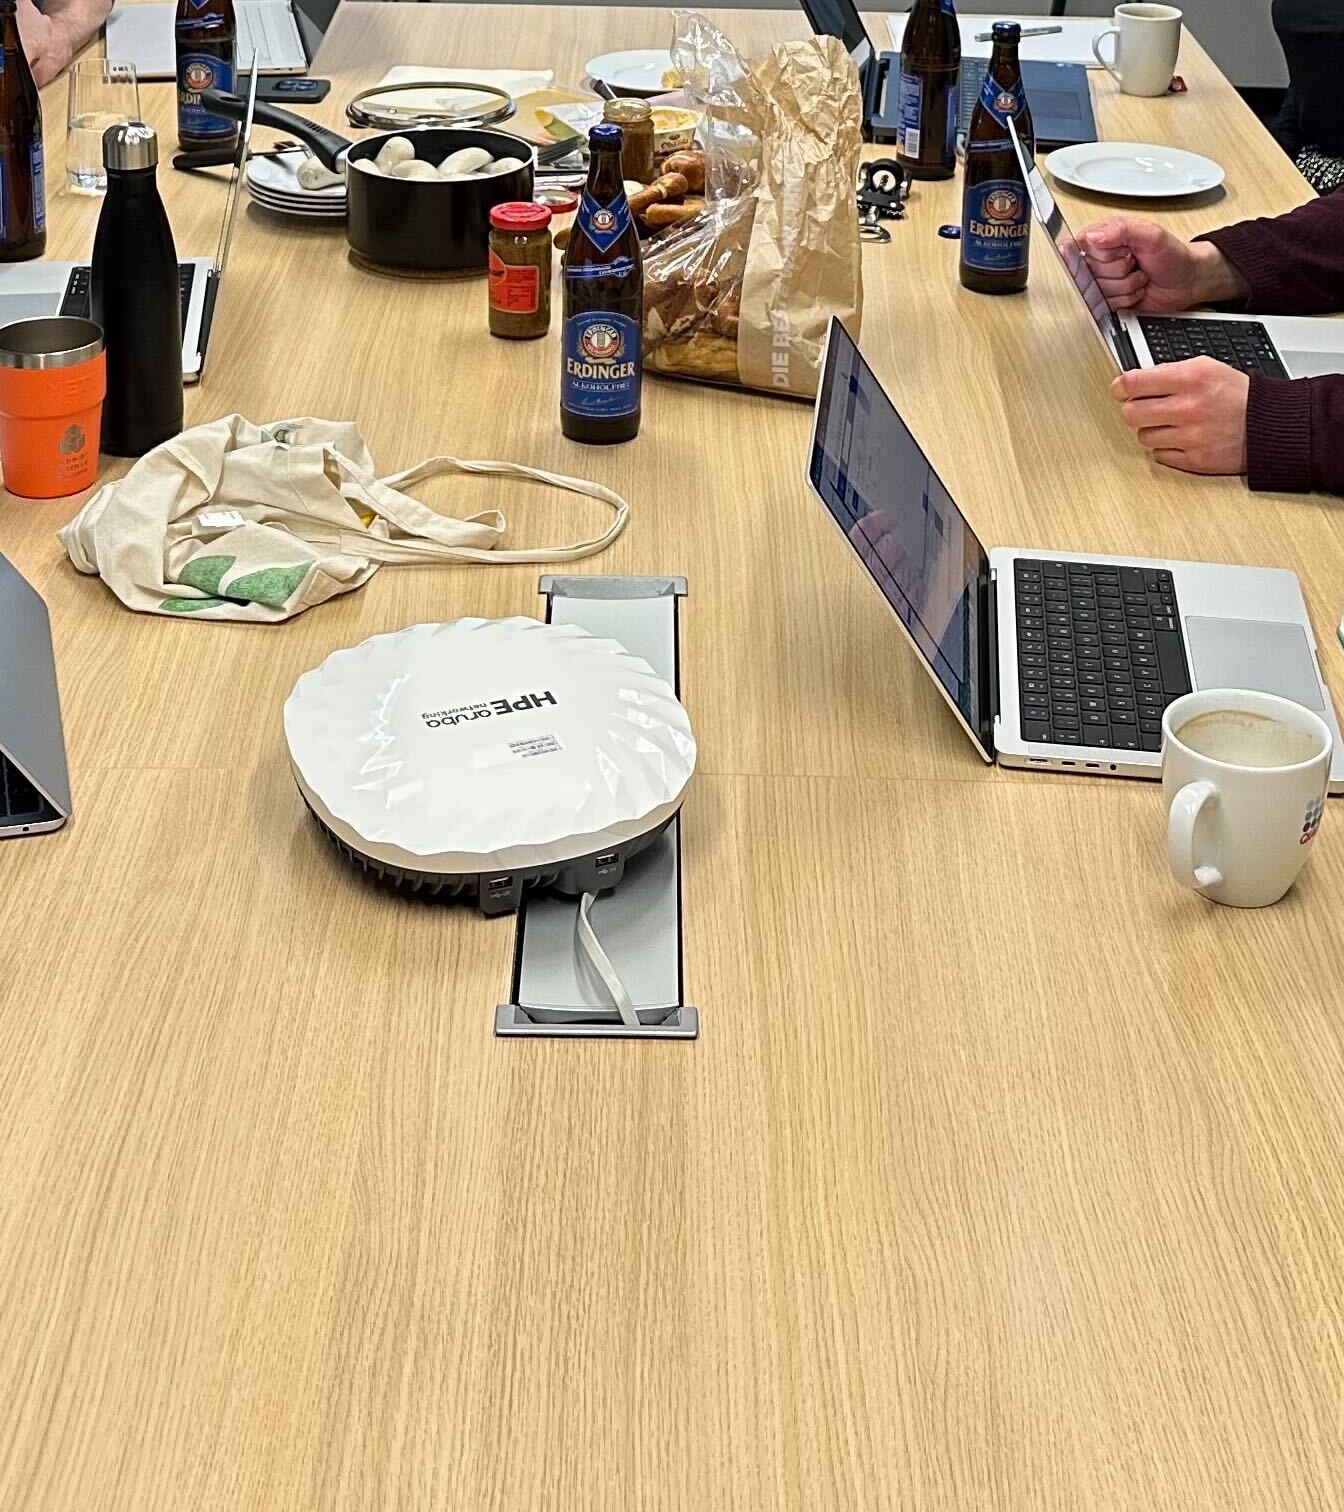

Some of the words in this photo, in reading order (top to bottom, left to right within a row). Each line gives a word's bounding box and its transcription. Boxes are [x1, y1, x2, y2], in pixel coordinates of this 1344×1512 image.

[970, 219, 1029, 238] ERDINGER
[567, 357, 636, 380] ERDINGER
[772, 352, 790, 387] DIE
[421, 702, 488, 720] networking
[489, 690, 558, 716] HPE
[425, 709, 492, 728] aruba
